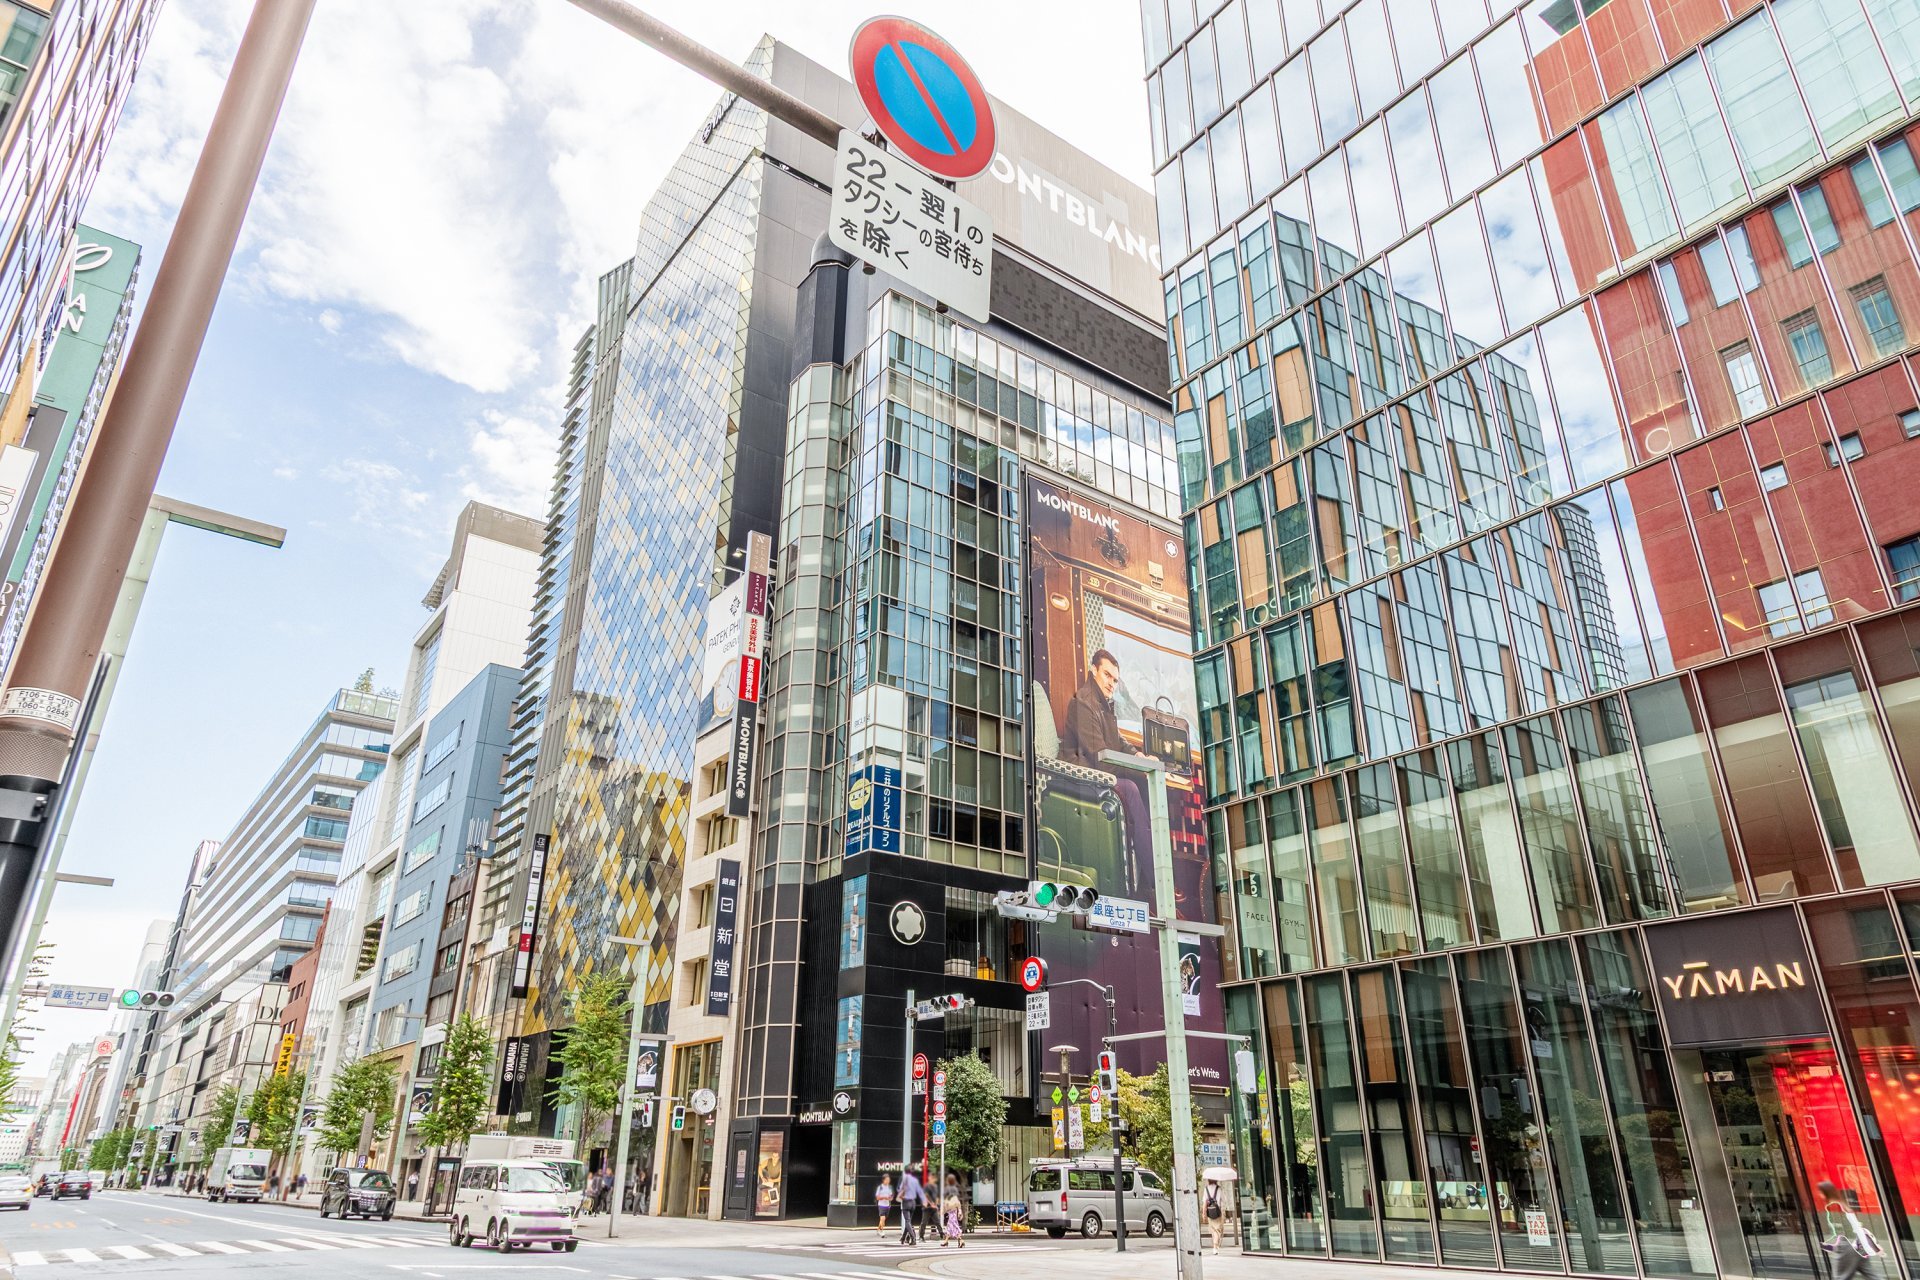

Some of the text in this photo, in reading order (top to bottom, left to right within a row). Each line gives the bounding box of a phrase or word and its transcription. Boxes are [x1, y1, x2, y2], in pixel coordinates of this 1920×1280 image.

[844, 179, 984, 276] タクシーの客待ち
[839, 217, 909, 270] を除く
[1037, 489, 1120, 533] MONTBLANC
[709, 629, 728, 650] PATEK
[736, 716, 751, 788] MONTBLANC
[721, 877, 736, 886] 銀座
[1093, 903, 1145, 923] 銀座七丁目
[1110, 918, 1126, 927] Ginza
[1246, 911, 1265, 923] FACE
[1284, 919, 1300, 927] GYM
[51, 989, 109, 1002] 銀座七丁目
[278, 1046, 292, 1073] ライオン
[505, 1041, 518, 1072] YAMAHA
[1188, 1066, 1220, 1079] et's Write
[800, 1110, 833, 1123] MONTBLAN
[1528, 1220, 1546, 1229] TAX
